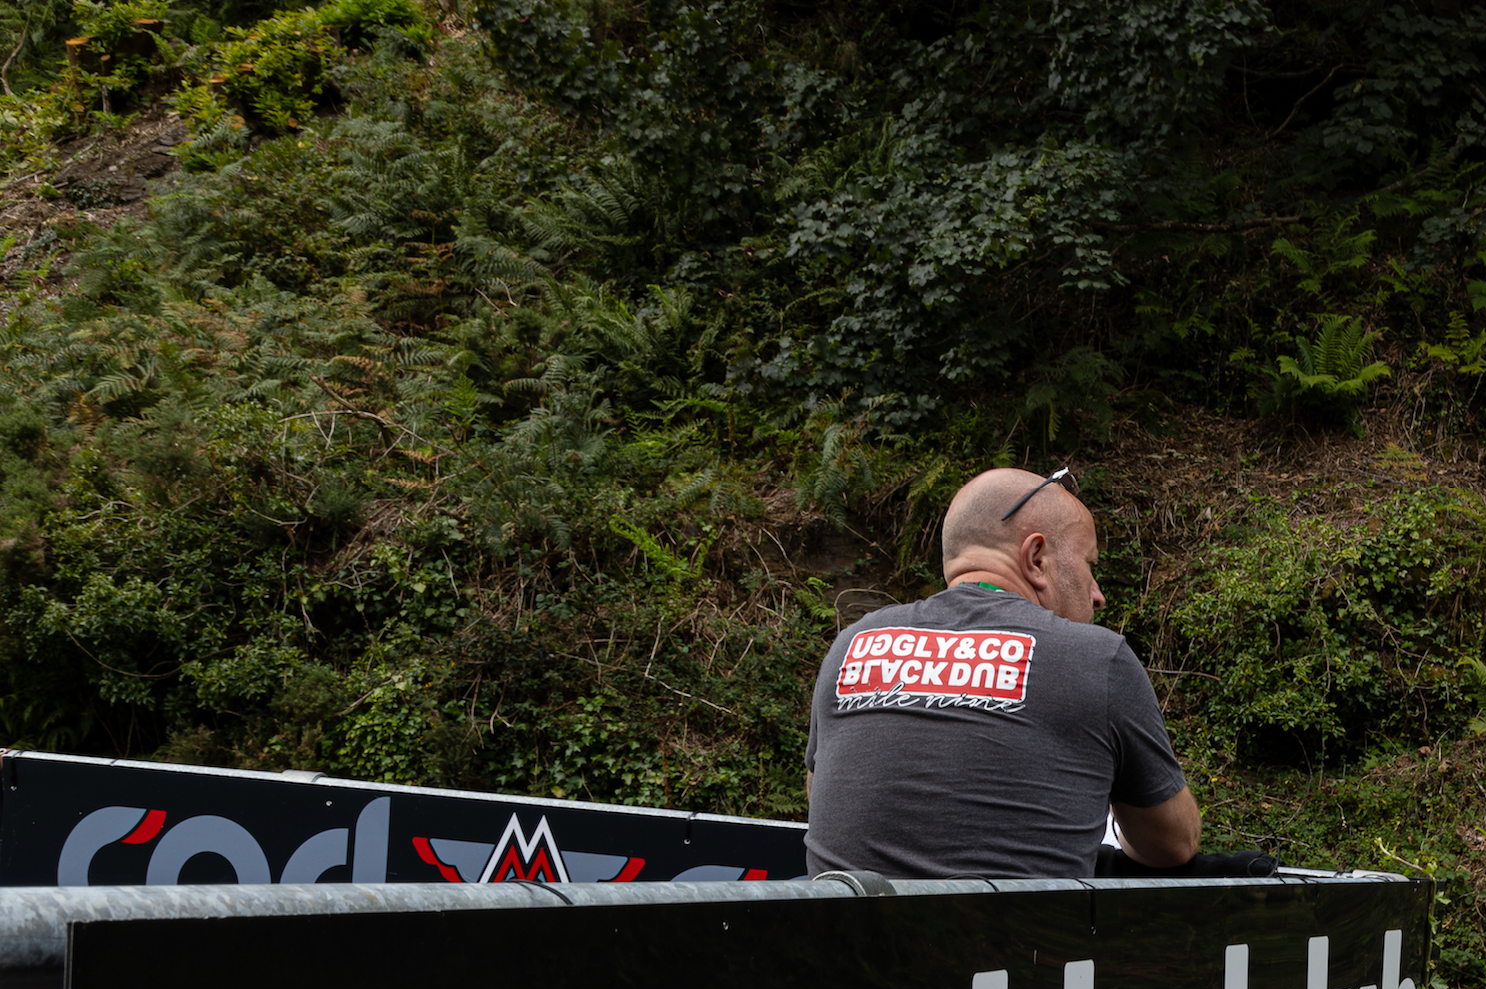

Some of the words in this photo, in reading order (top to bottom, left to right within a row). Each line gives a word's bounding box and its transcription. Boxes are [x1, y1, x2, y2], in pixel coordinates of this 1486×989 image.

[852, 633, 1025, 663] UGGLY&CO
[842, 658, 949, 685] BLACK
[948, 662, 1020, 691] DUB
[837, 681, 921, 711] mile
